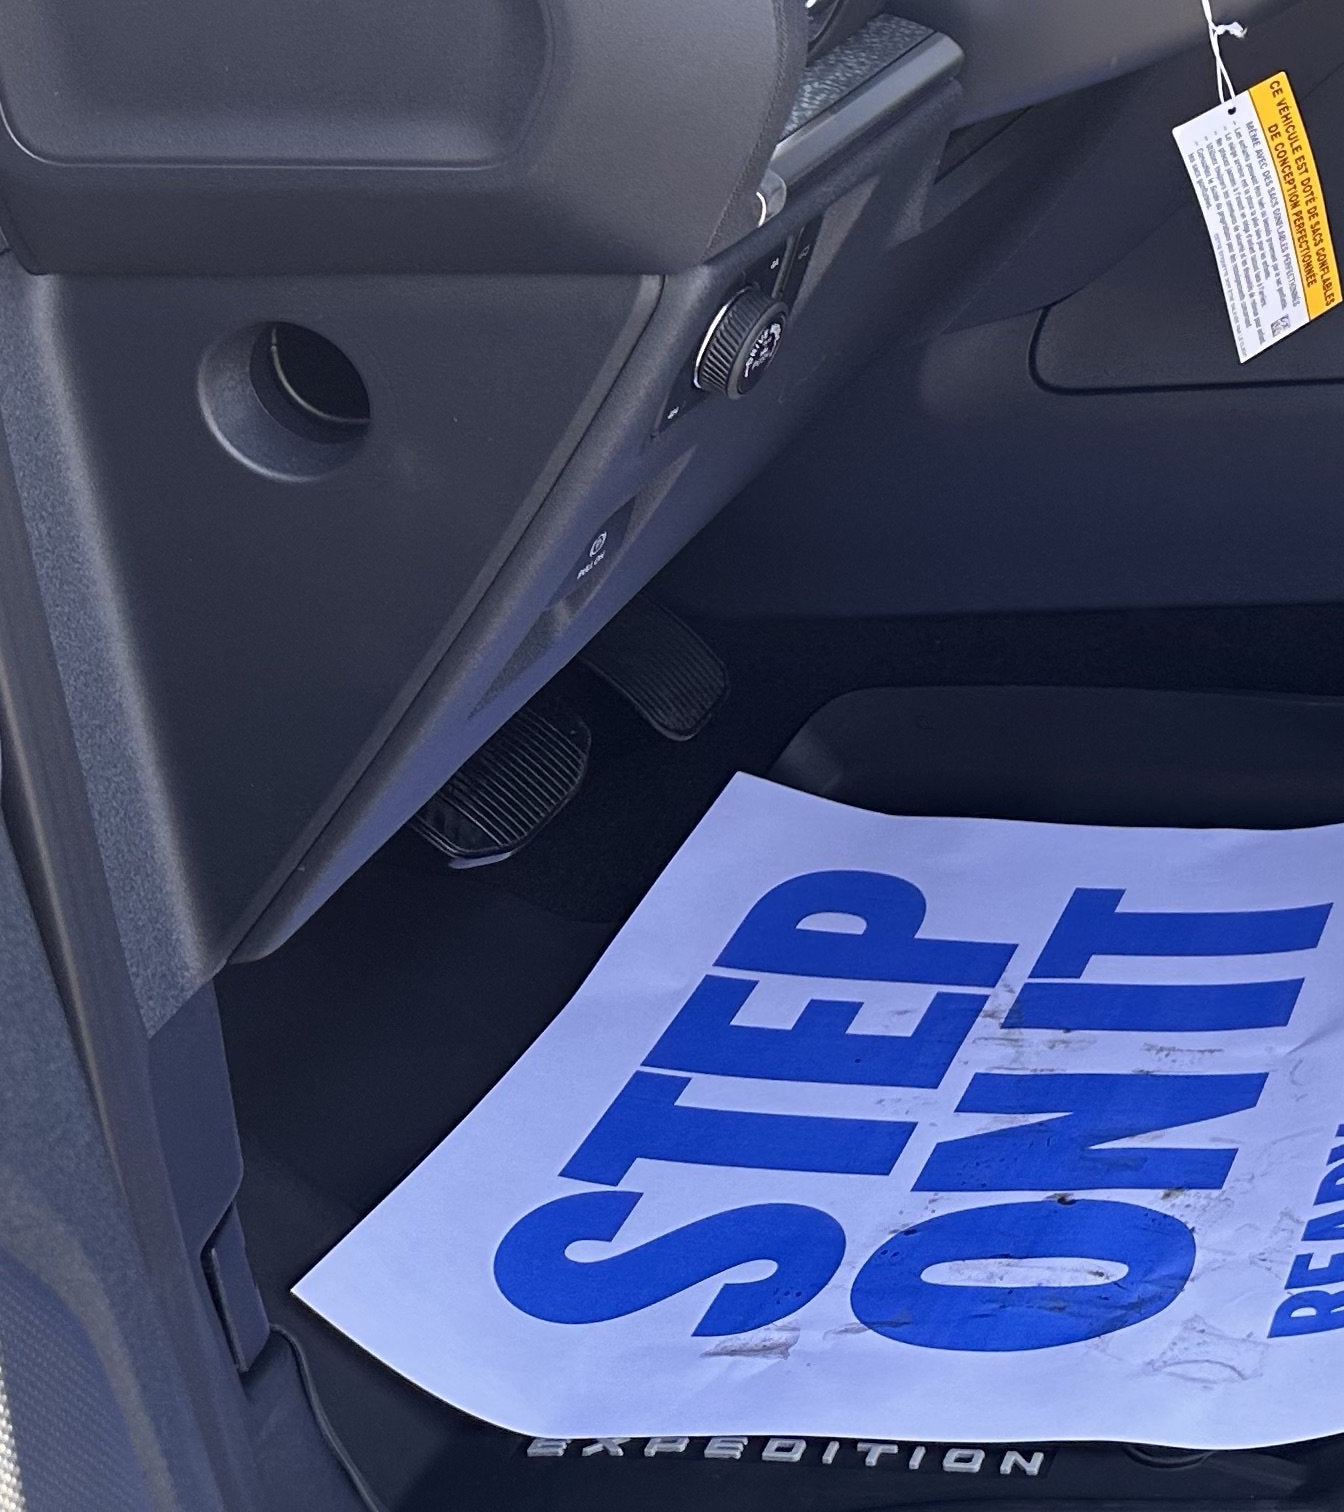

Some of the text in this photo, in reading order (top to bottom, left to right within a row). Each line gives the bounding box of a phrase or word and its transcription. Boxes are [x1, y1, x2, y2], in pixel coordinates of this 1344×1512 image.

[1269, 80, 1284, 98] CE
[1268, 123, 1281, 141] DE
[1274, 142, 1301, 210] CONCEPTION
[1294, 155, 1309, 176] EST
[1300, 177, 1318, 206] DOTÉ
[1307, 206, 1319, 221] DE
[1311, 221, 1323, 247] SACS
[494, 870, 1019, 1336] STEP
[851, 888, 1334, 1352] ON IT
[527, 1437, 1044, 1476] EXPEDITION
